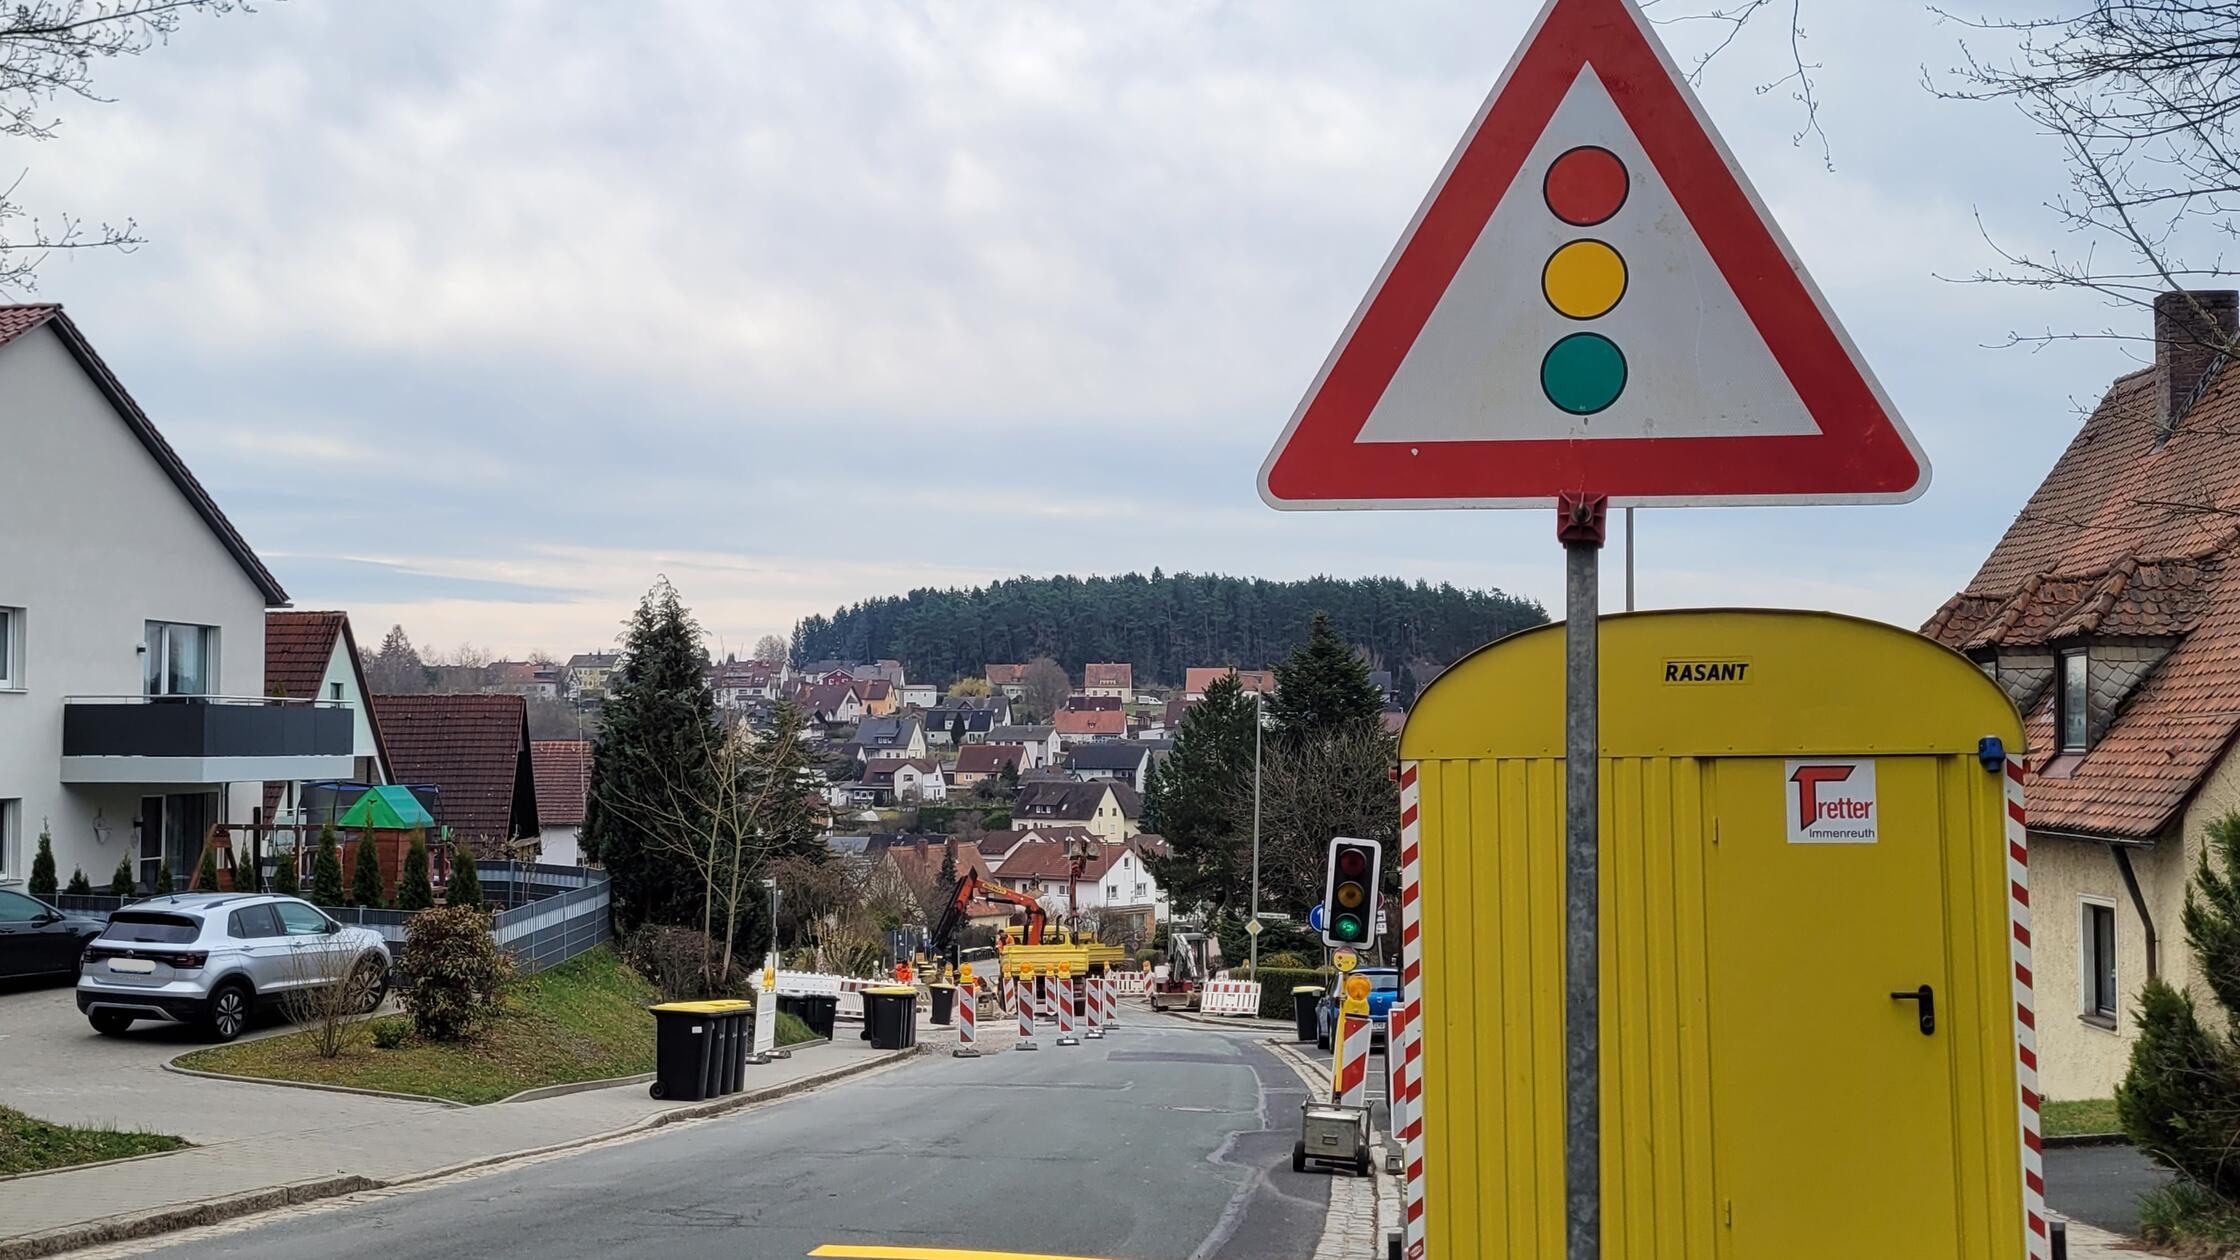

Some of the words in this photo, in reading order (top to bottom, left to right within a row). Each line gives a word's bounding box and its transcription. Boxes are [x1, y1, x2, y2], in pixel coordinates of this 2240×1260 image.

[1665, 663, 1749, 682] RASANT
[1789, 765, 1874, 831] Tretter
[1809, 828, 1875, 838] Immenreuth
